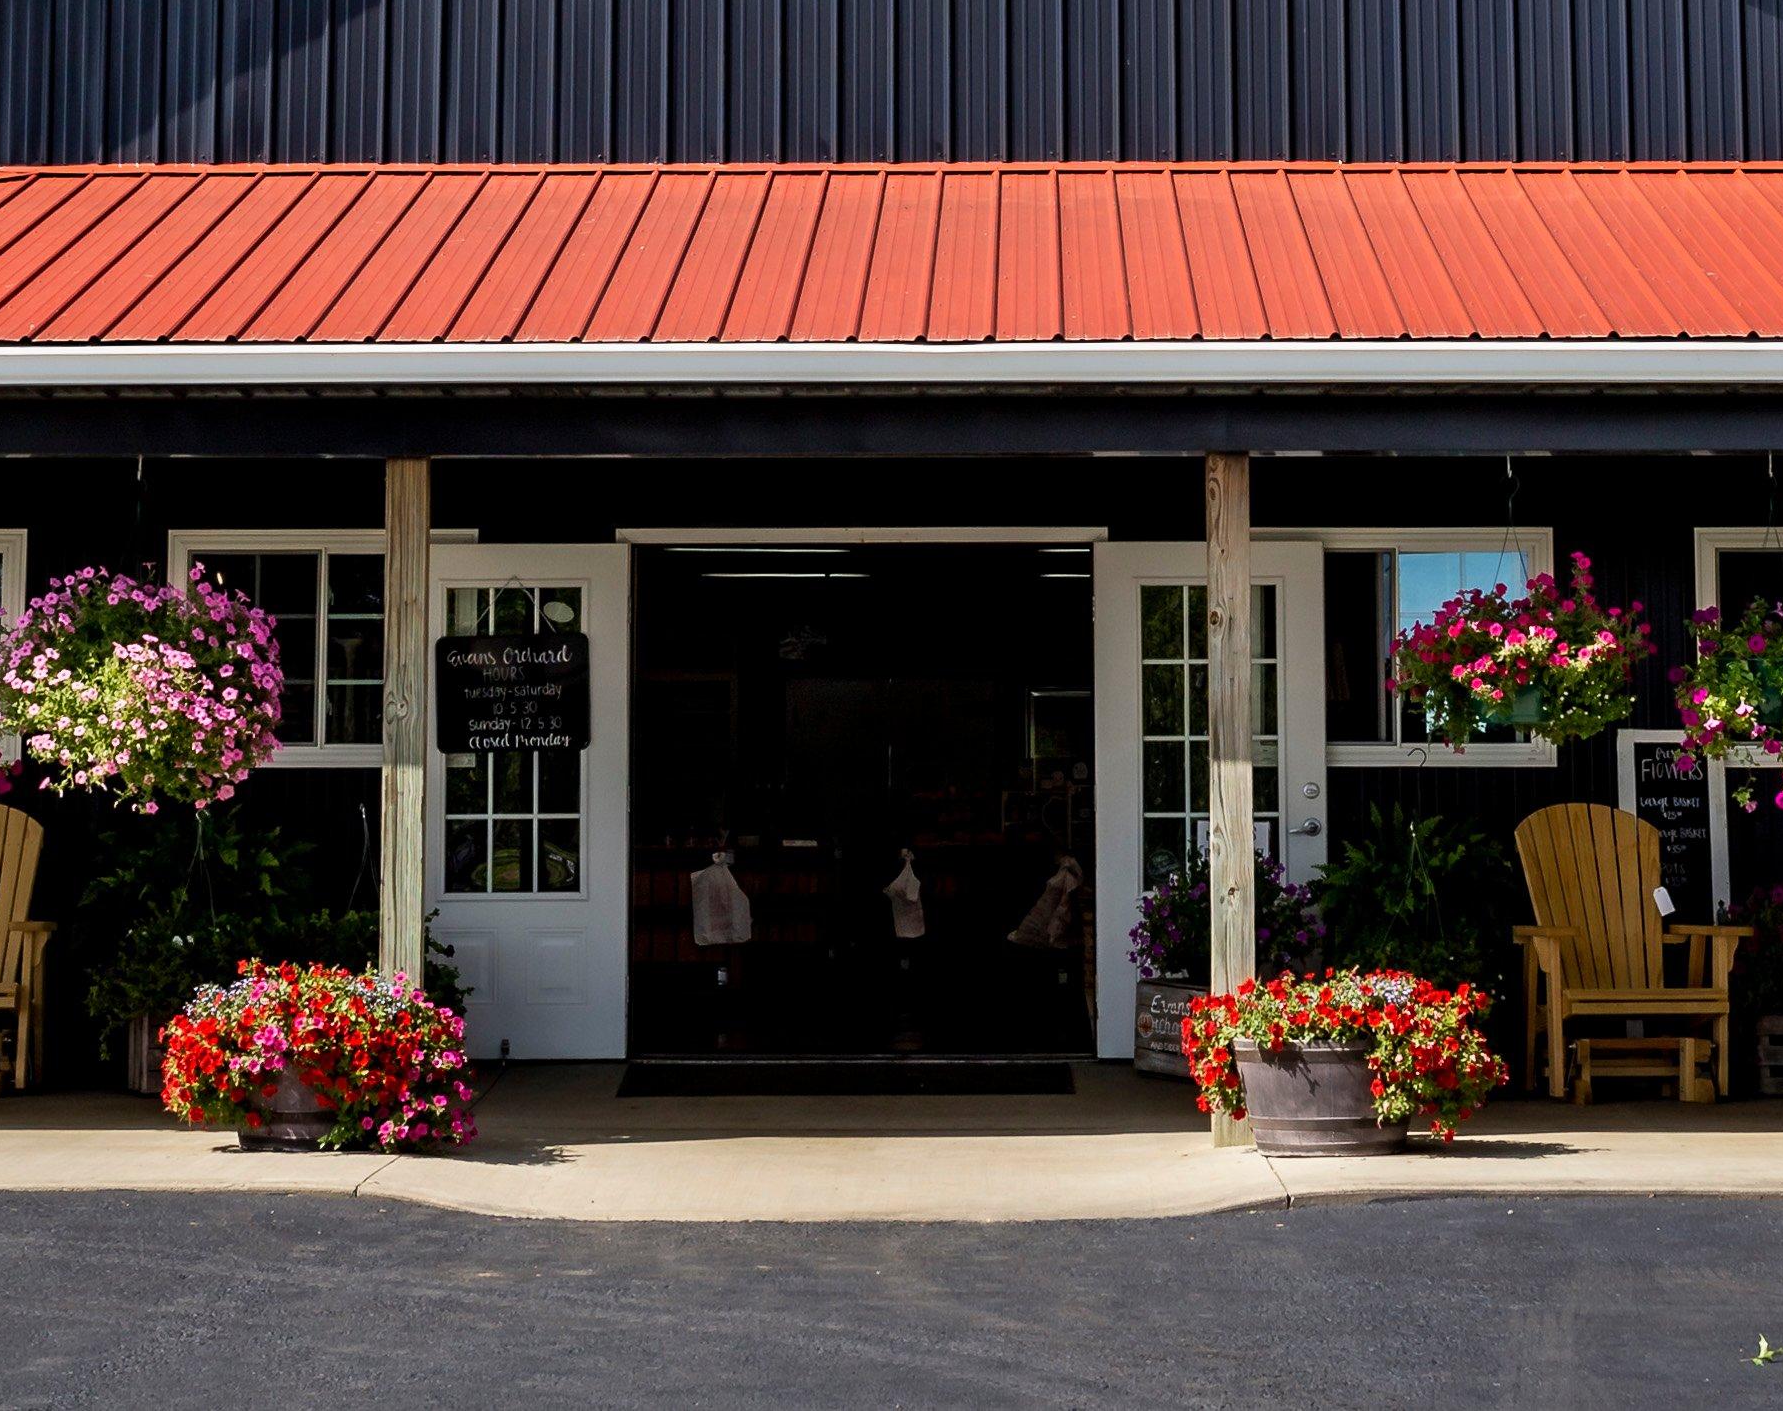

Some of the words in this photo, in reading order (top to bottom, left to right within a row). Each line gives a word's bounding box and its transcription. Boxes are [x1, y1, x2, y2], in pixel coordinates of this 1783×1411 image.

[446, 650, 497, 667] Evans
[502, 644, 573, 665] Orchard
[483, 666, 526, 682] HOURS
